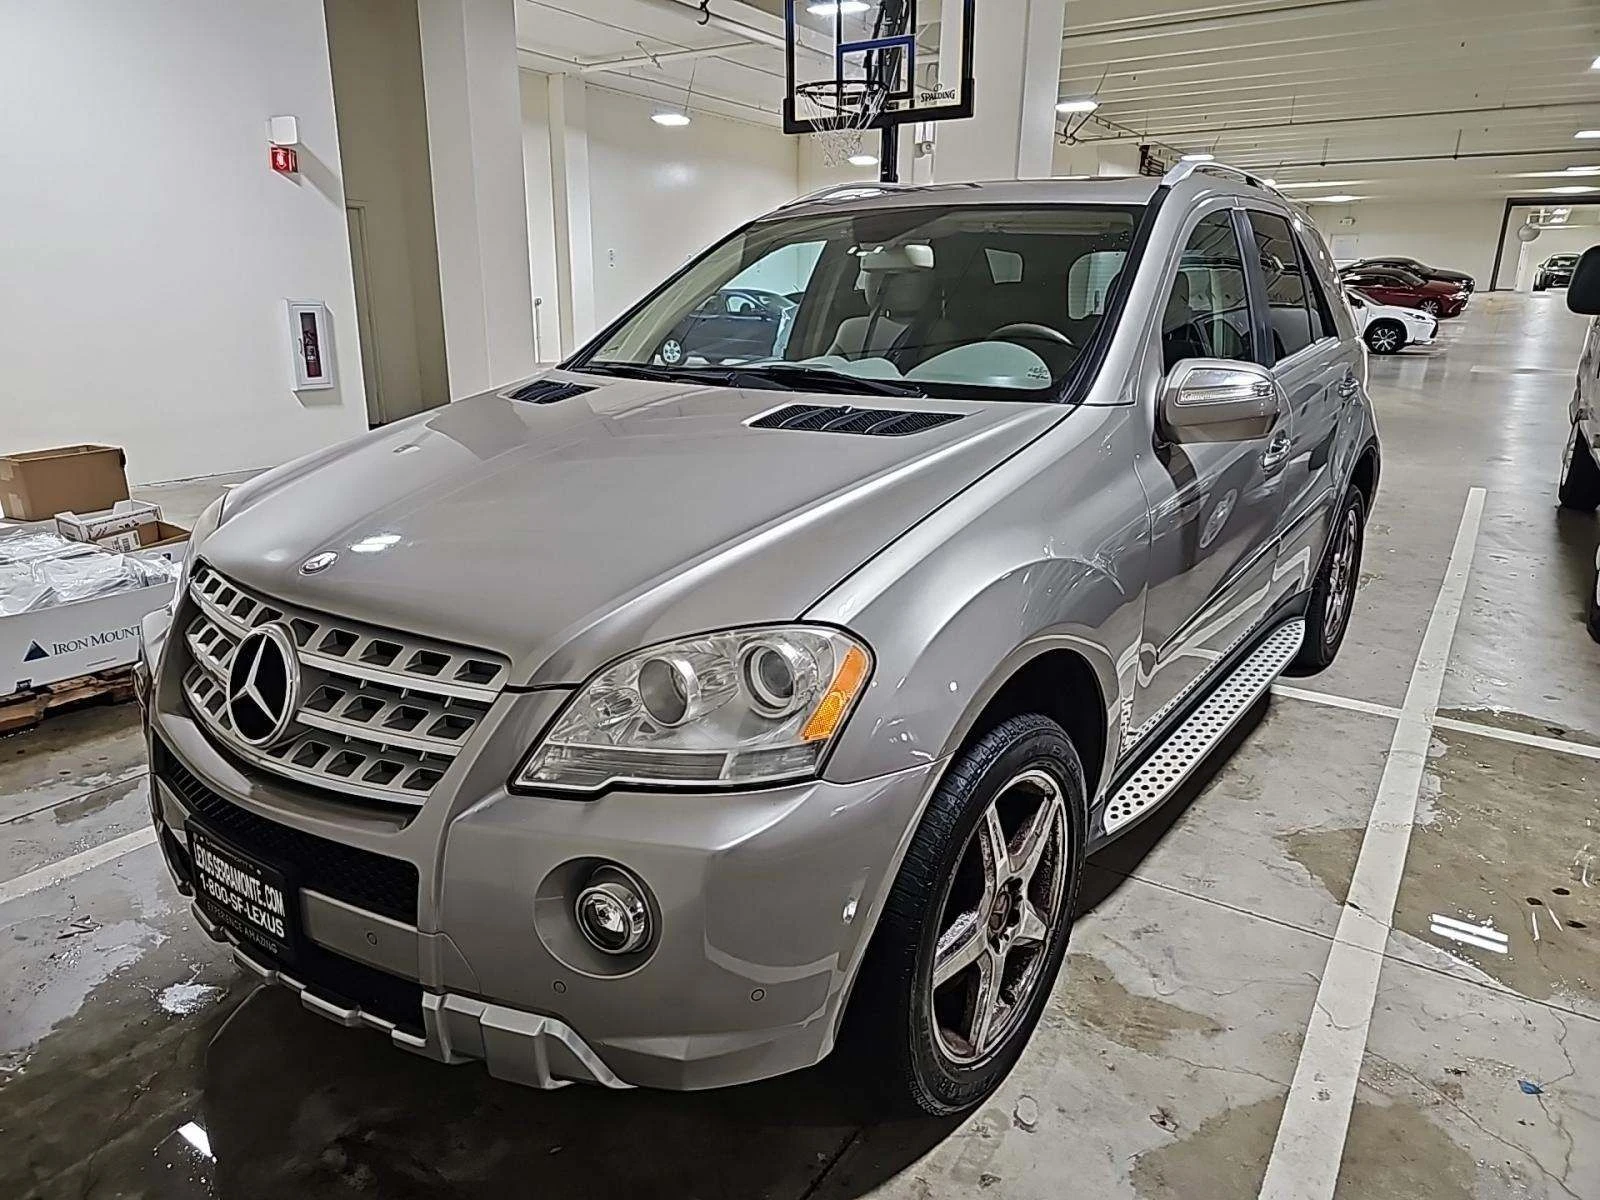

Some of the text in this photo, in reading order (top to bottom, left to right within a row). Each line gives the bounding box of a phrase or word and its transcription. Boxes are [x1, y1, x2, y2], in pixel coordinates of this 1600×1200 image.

[920, 89, 955, 102] SPALDING
[53, 638, 88, 655] IRON
[200, 872, 285, 938] 1-800-SF-LEXUS
[244, 928, 278, 954] AMAZING
